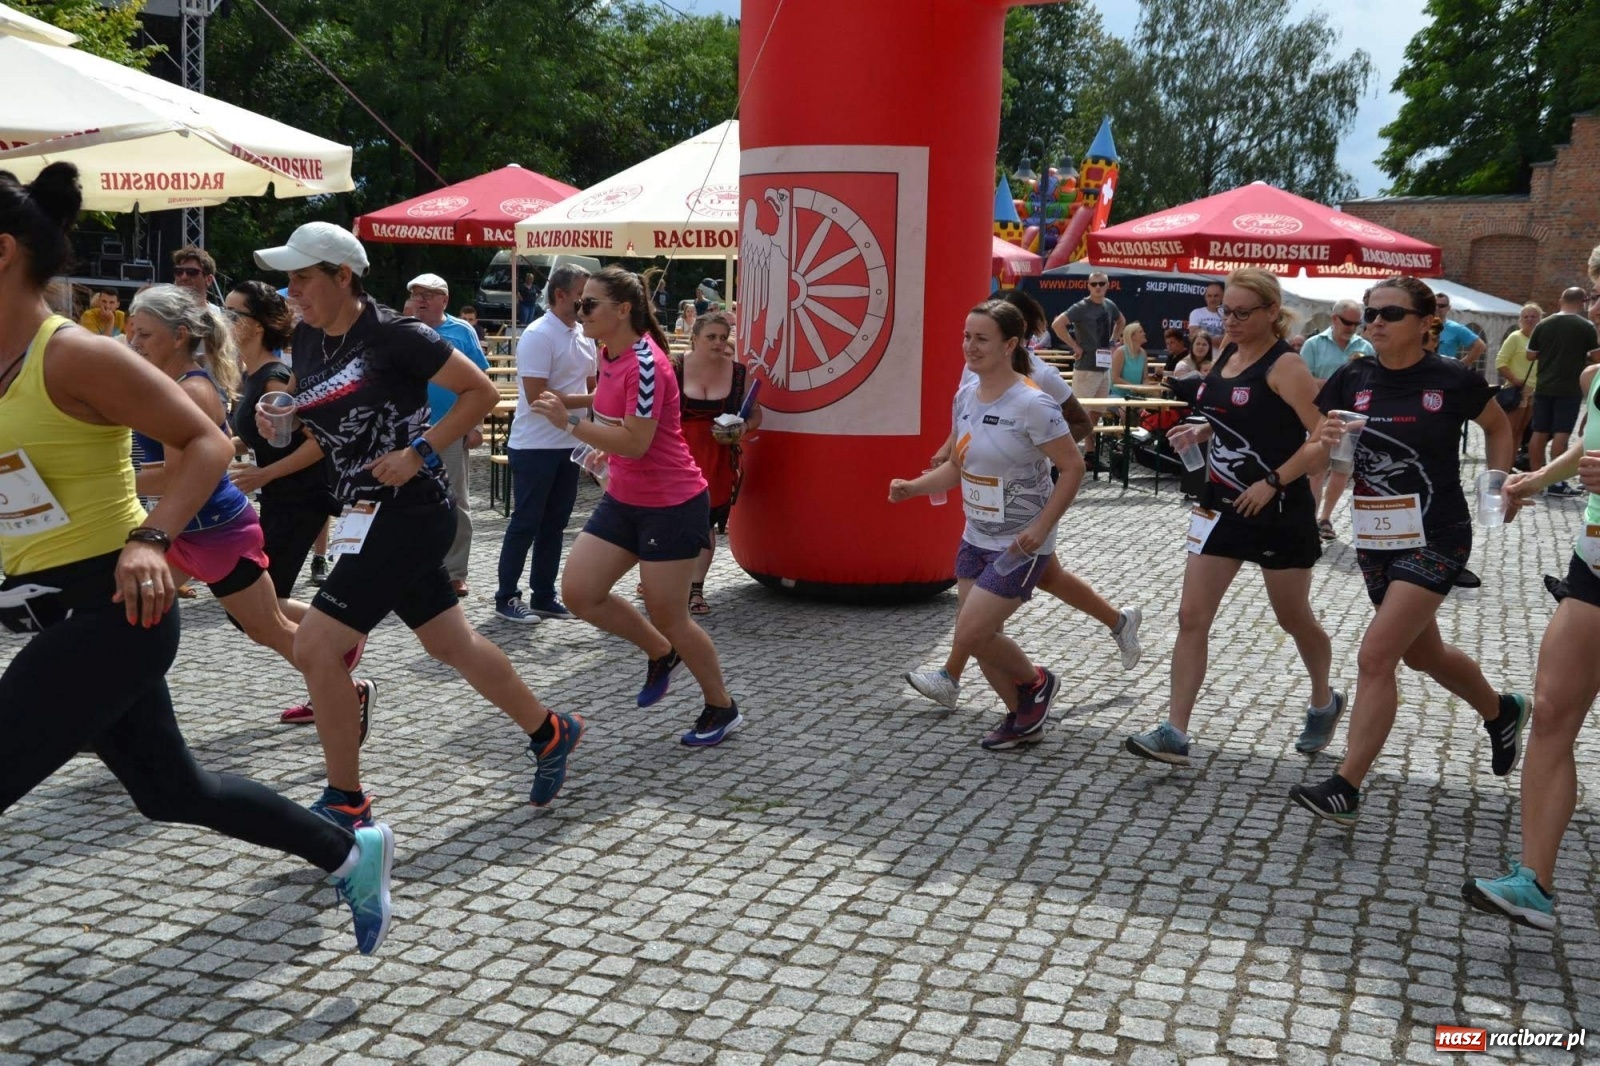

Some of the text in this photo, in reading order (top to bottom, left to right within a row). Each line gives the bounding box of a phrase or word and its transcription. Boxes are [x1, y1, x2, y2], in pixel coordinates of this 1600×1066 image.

[371, 222, 455, 241] RACIBORSKIE
[483, 227, 515, 242] RAC
[526, 230, 613, 249] RACIBORSKIE
[1097, 240, 1185, 256] RACIBORSKIE
[1209, 241, 1330, 261] RACIBORSKIE
[1361, 247, 1433, 269] RACIBORSKIE
[1146, 281, 1207, 296] SKLEP INTERNETO
[299, 370, 328, 390] GRYF
[969, 488, 980, 502] 20
[1373, 516, 1392, 531] 25
[320, 591, 348, 609] COLO
